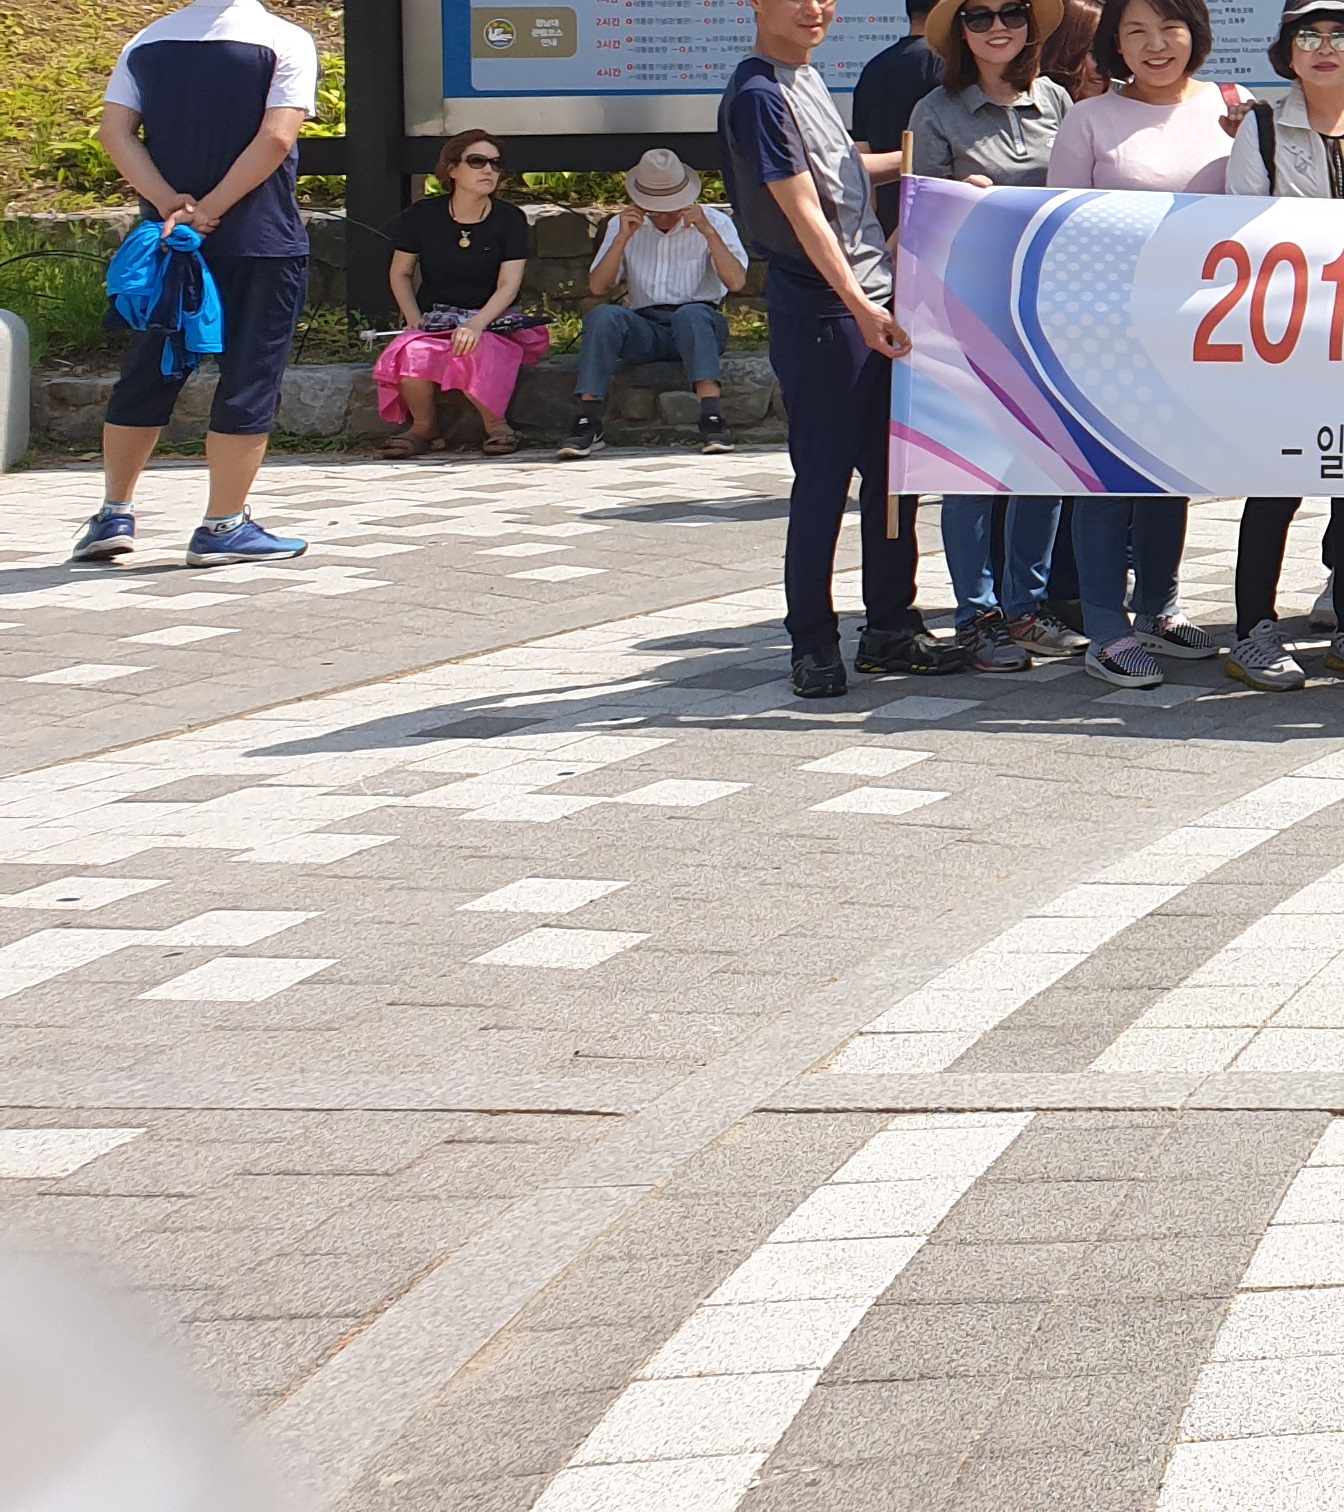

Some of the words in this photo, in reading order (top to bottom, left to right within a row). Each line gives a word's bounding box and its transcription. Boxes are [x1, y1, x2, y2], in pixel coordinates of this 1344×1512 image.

[596, 18, 620, 27] 2시간
[596, 40, 621, 49] 3시간
[597, 68, 621, 77] 4시간
